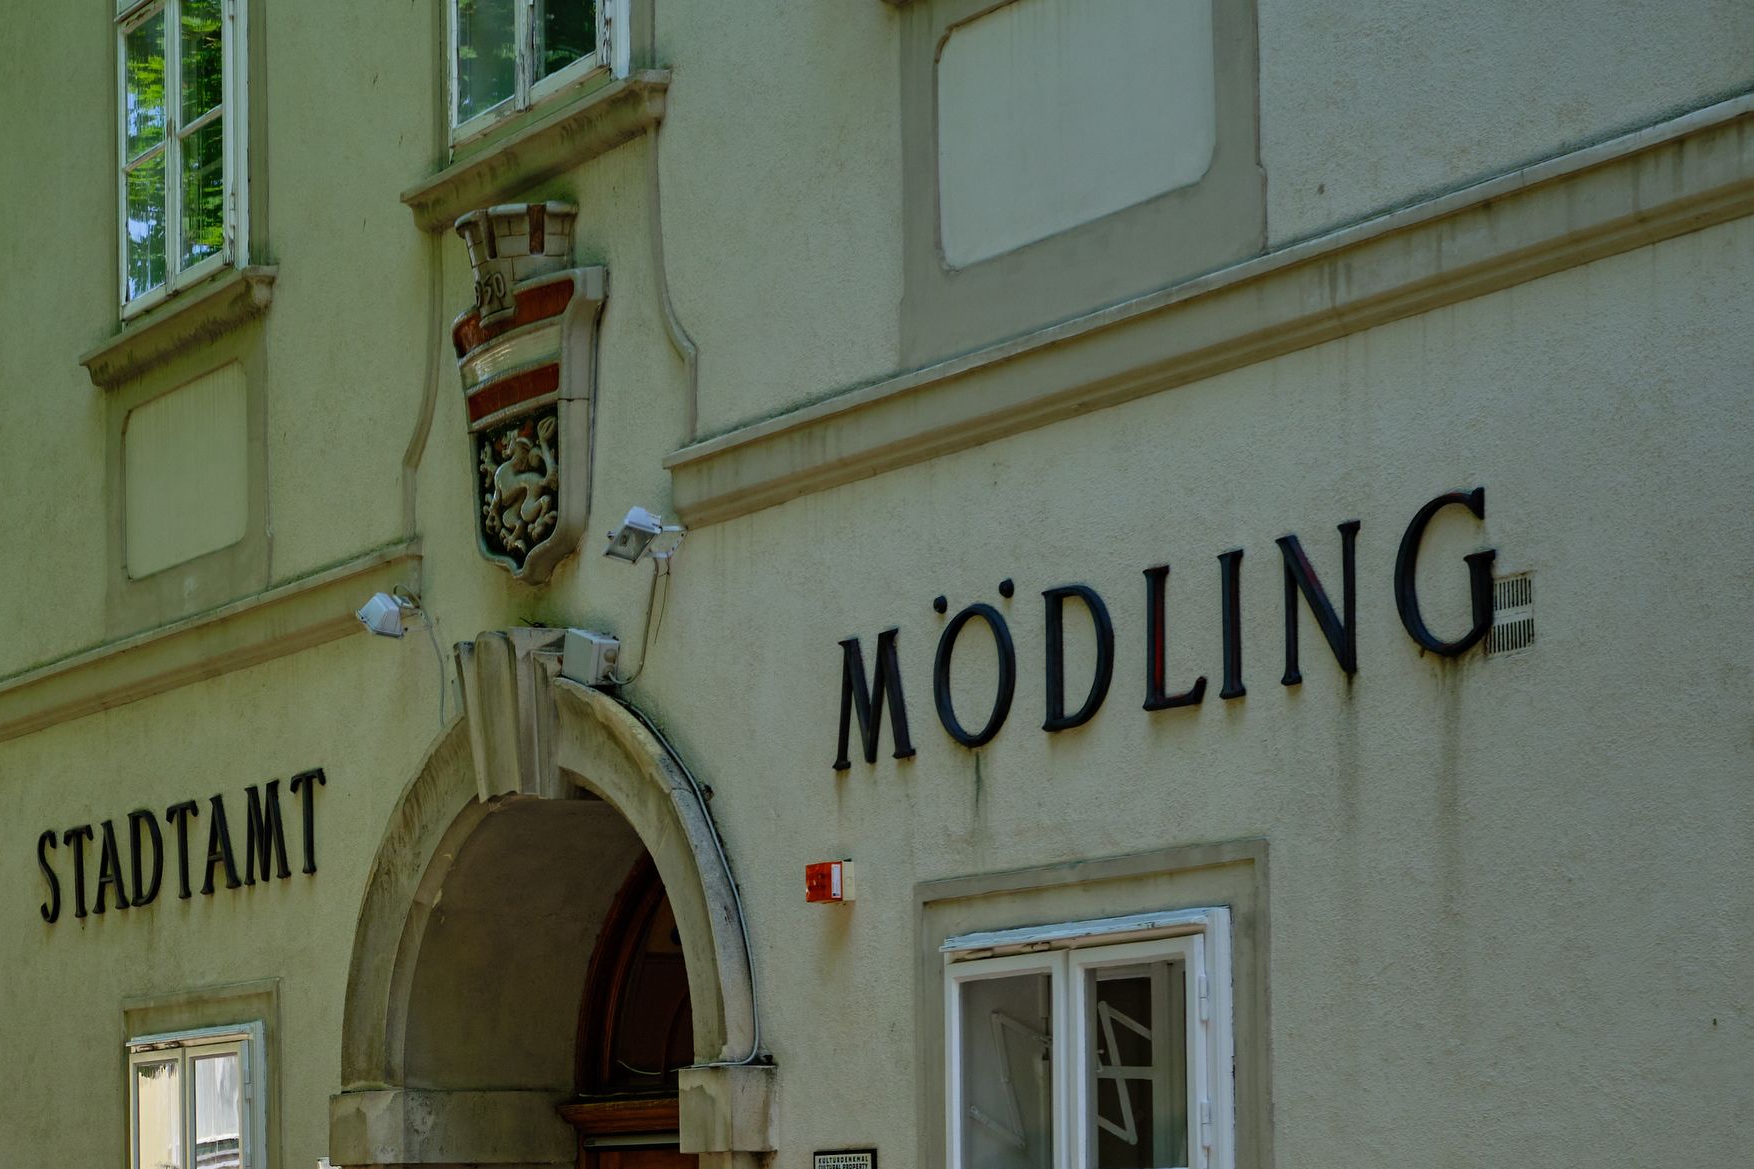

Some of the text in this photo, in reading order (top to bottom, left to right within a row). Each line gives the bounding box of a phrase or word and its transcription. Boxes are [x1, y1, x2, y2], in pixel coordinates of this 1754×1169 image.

[833, 487, 1495, 770] MÖDLING
[37, 767, 327, 924] STADTAMT
[818, 1156, 868, 1164] KULTURDENKMAL
